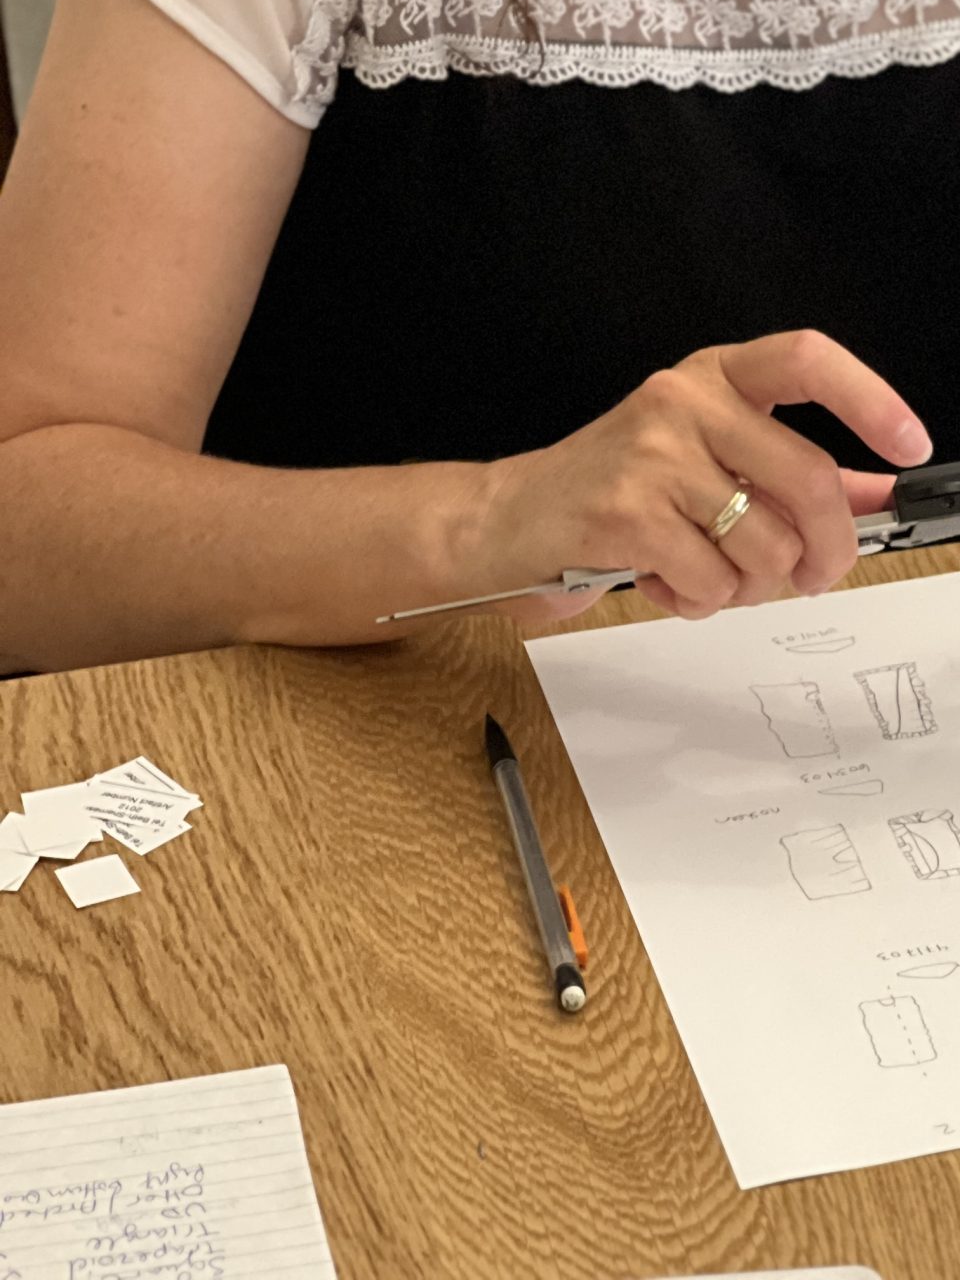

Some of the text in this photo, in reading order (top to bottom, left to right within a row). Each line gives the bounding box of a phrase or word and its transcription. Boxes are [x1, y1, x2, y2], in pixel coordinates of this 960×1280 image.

[100, 791, 138, 803] Number
[117, 802, 143, 813] 2012
[152, 818, 166, 828] Tel
[84, 1222, 219, 1252] Triangle
[67, 1241, 225, 1280] Trapezoid
